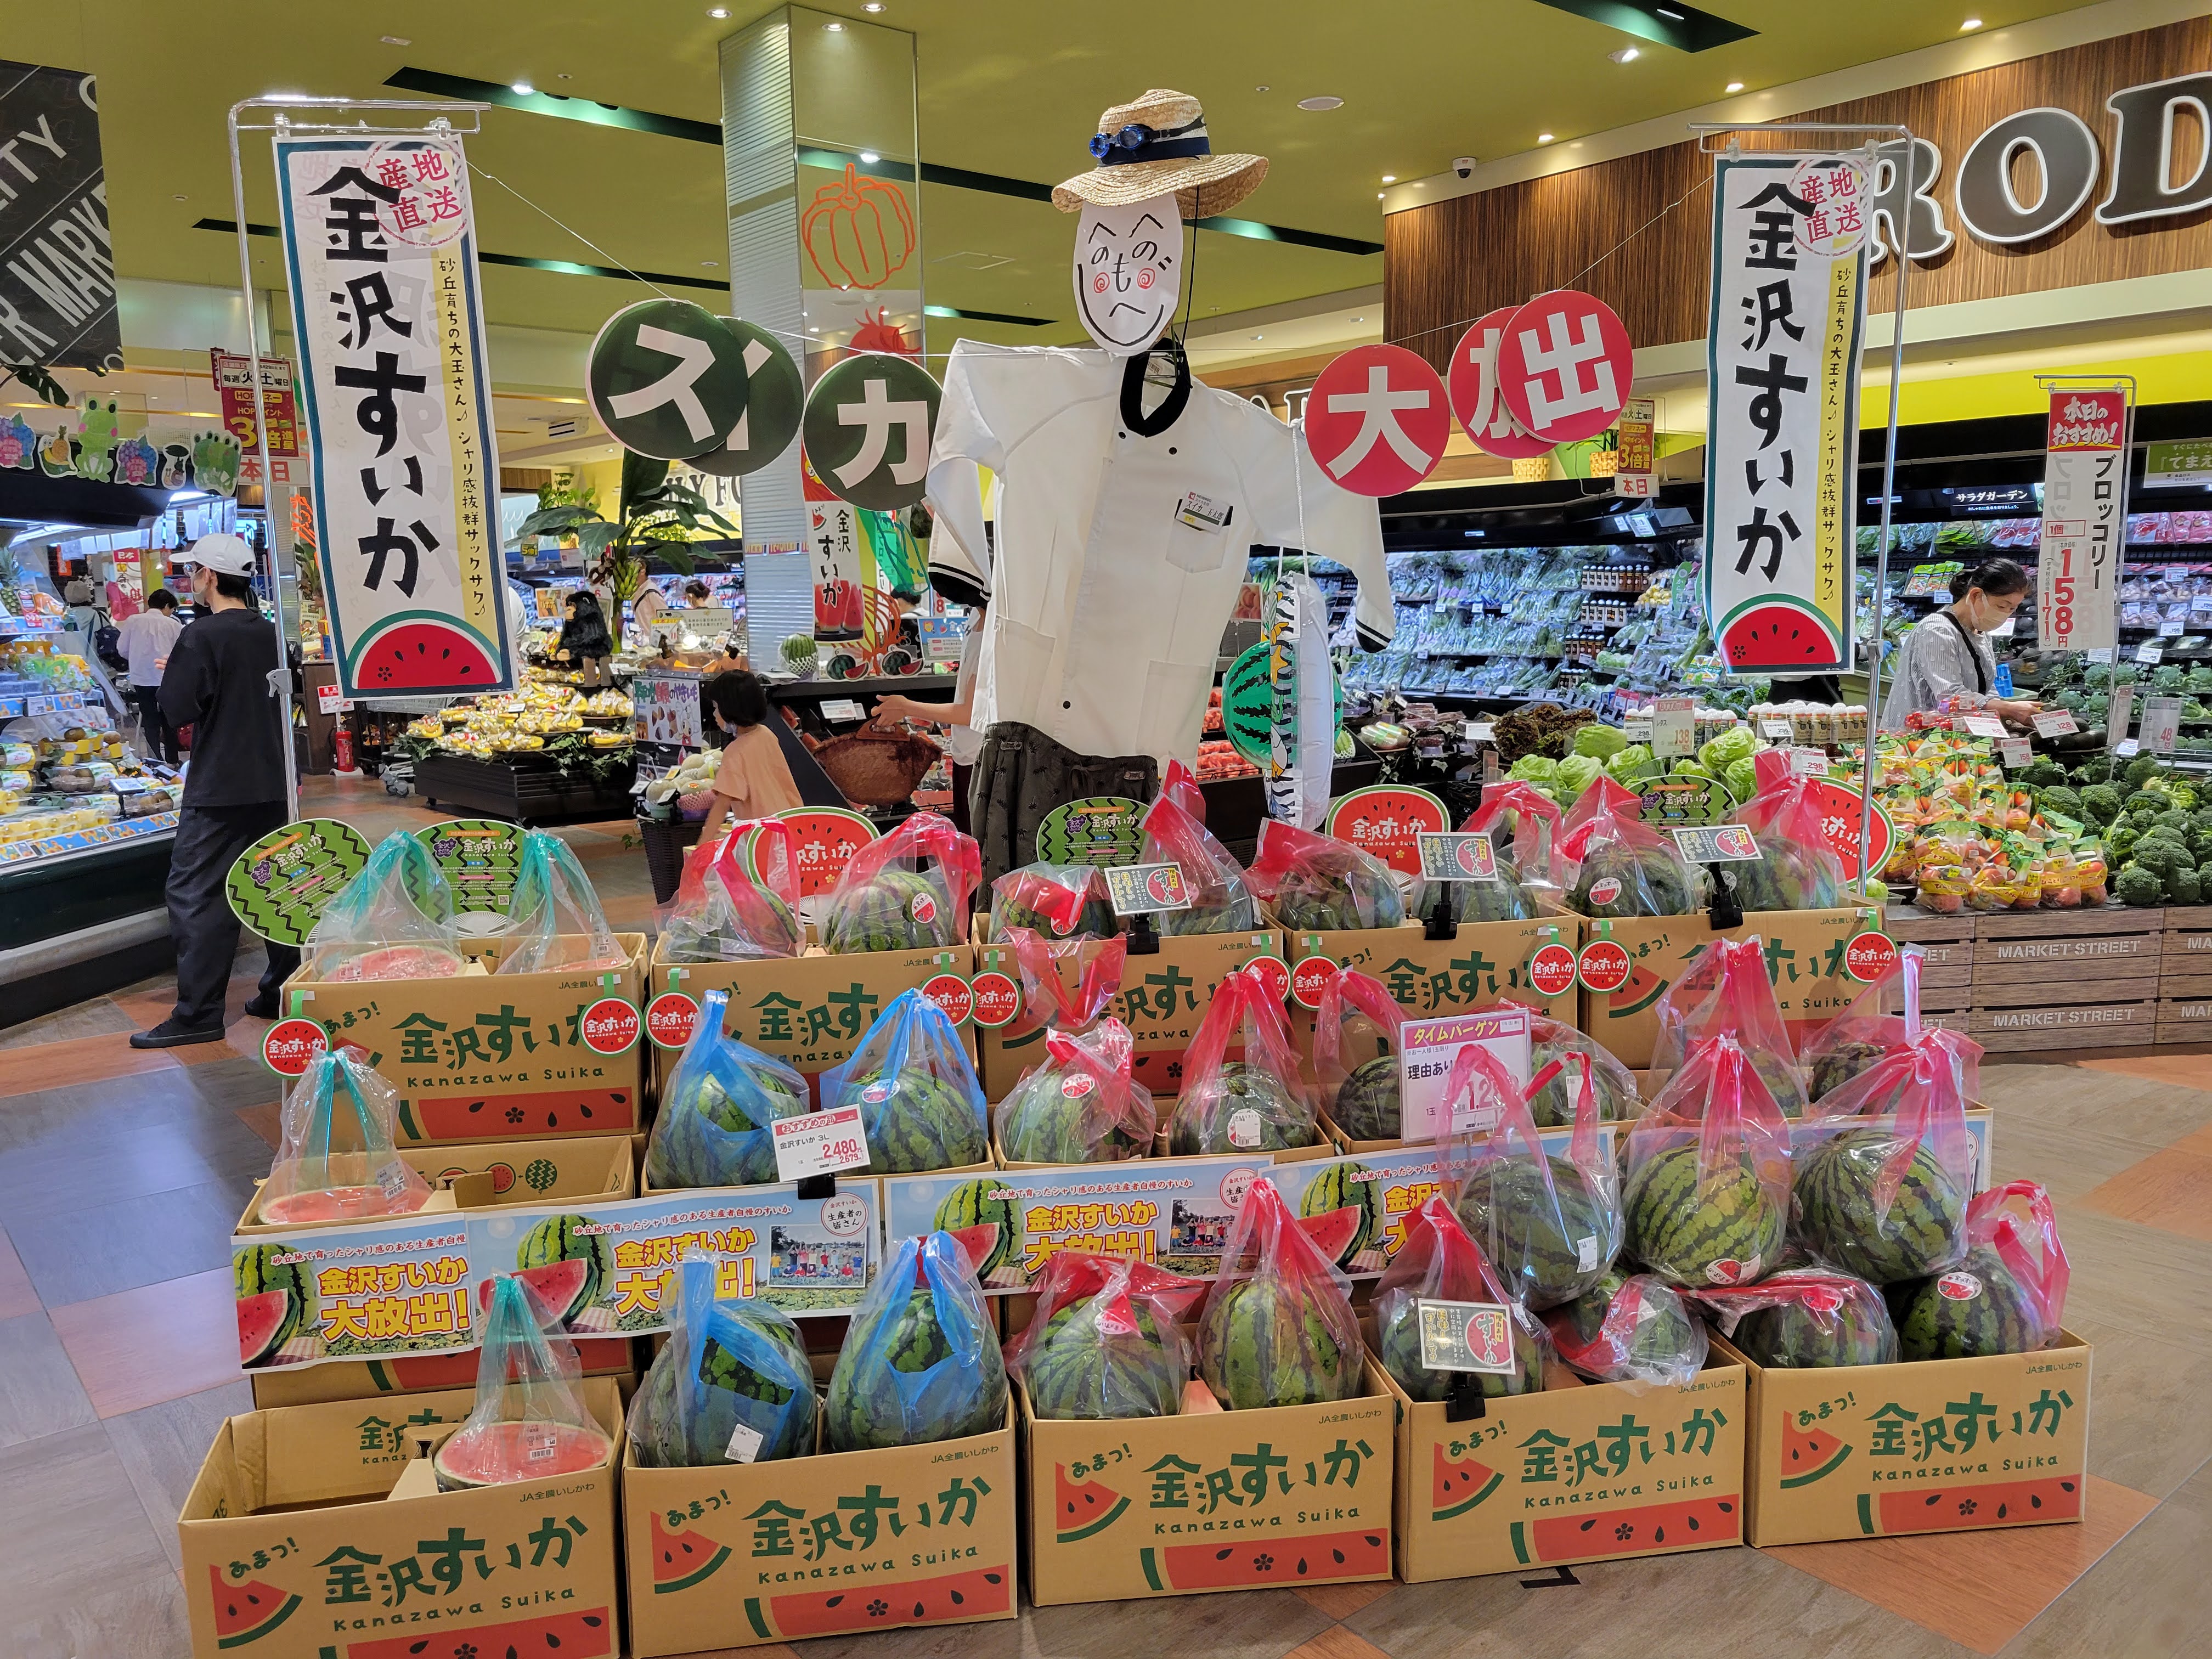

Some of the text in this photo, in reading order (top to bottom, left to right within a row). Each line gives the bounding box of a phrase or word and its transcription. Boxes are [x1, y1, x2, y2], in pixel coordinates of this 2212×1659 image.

[388, 185, 463, 233] 直送
[1804, 201, 1863, 244] 直送
[236, 392, 281, 402] HOPネー
[305, 166, 441, 599] 金沢すいか
[1734, 183, 1809, 583] 金沢すいか
[2090, 454, 2118, 590] ブロッコリー
[1675, 729, 1690, 745] 138
[2160, 726, 2173, 741] 48
[1350, 818, 1427, 840] 金沢すいか
[1154, 869, 1175, 904] すいか
[1581, 956, 1627, 972] 金沢すいか
[1997, 940, 2141, 959] MARKET STREET
[1380, 950, 1532, 1011] 金沢すい
[1533, 960, 1575, 977] 金沢すいか
[584, 1014, 637, 1034] 金沢すいか
[1413, 1019, 1499, 1046] タイムバーゲン
[1993, 1008, 2136, 1027] MARKET STREET
[407, 1066, 605, 1088] Kanazawa Suika
[780, 1136, 816, 1150] 金沢すいか
[1025, 1200, 1159, 1233] 金沢すいか
[317, 1256, 469, 1297] 金沢すいか
[321, 1288, 473, 1344] 大放出!
[1476, 1312, 1498, 1364] すいか
[1863, 1388, 2074, 1463] 金沢すいか
[362, 1454, 408, 1465] Kanaz
[1514, 1407, 1729, 1487] 金沢すいか
[1141, 1437, 1375, 1516] 金沢すいか
[1872, 1453, 2059, 1482] Kanazawa Suika
[1525, 1473, 1714, 1509] Kanazawa Suika
[741, 1475, 993, 1562] 金沢すいか
[1154, 1505, 1361, 1535] Kanazawa Suika
[312, 1515, 589, 1609] 金沢すいか
[758, 1545, 979, 1585] Kanazawa Suika
[334, 1585, 577, 1632] Kanazawa Suika
